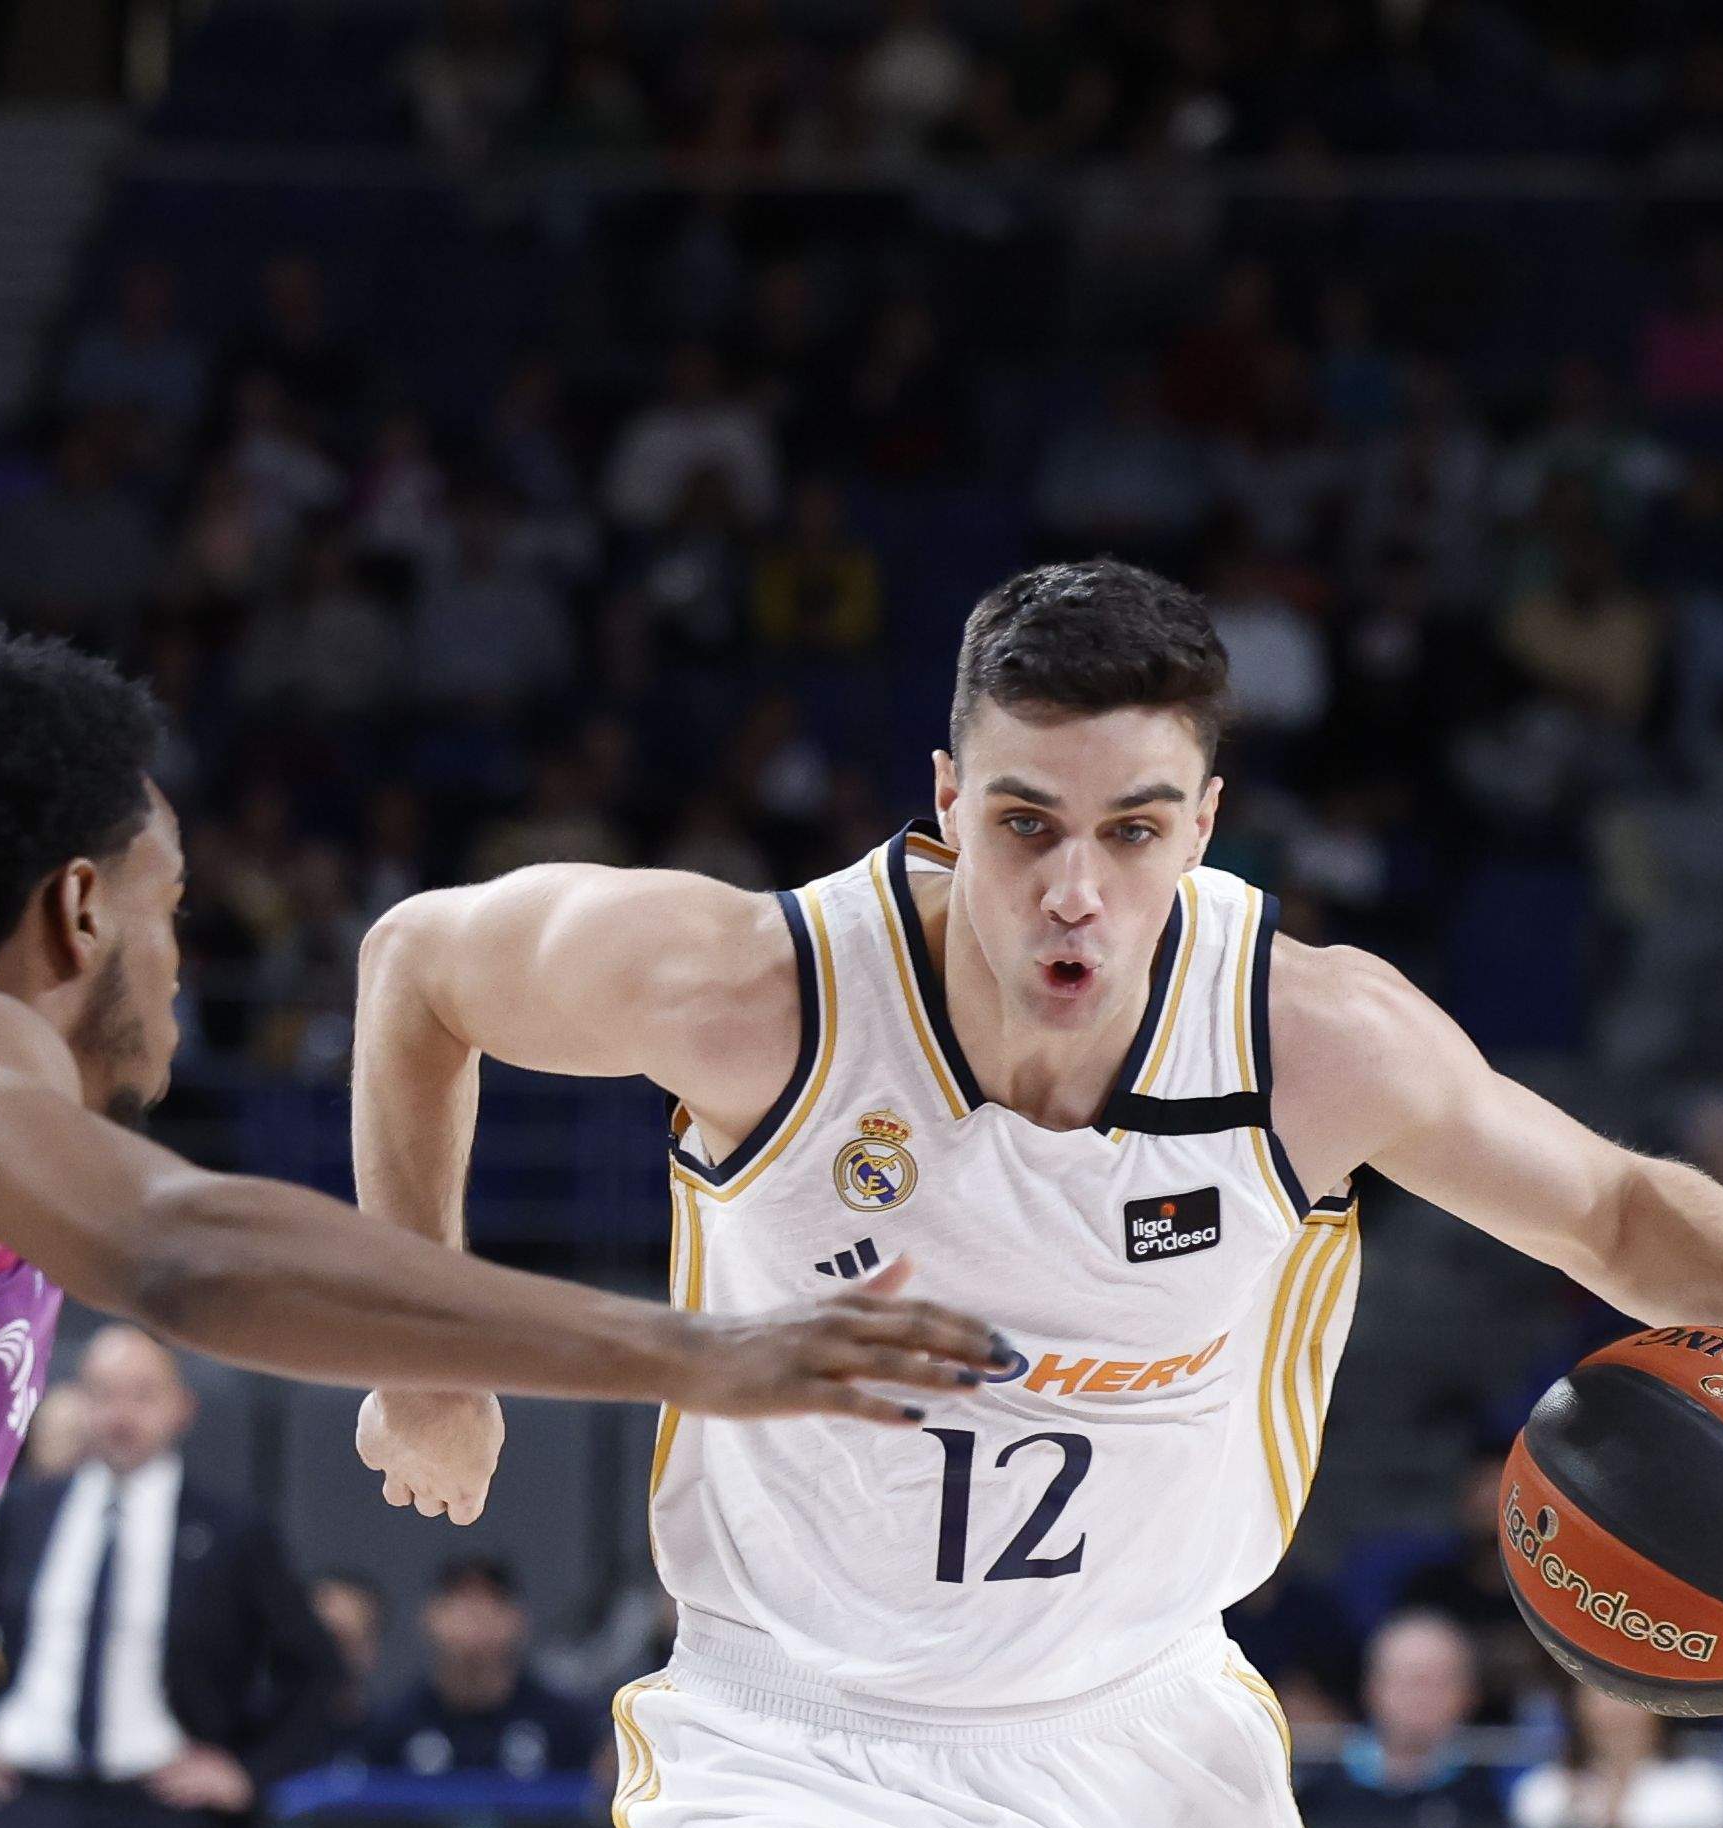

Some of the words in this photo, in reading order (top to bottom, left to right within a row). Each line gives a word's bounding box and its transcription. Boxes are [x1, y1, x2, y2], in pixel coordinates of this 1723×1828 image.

[1132, 1218, 1172, 1239] liga
[1133, 1227, 1216, 1255] endesa
[923, 1427, 1093, 1584] 12
[1539, 1552, 1718, 1664] endesa
